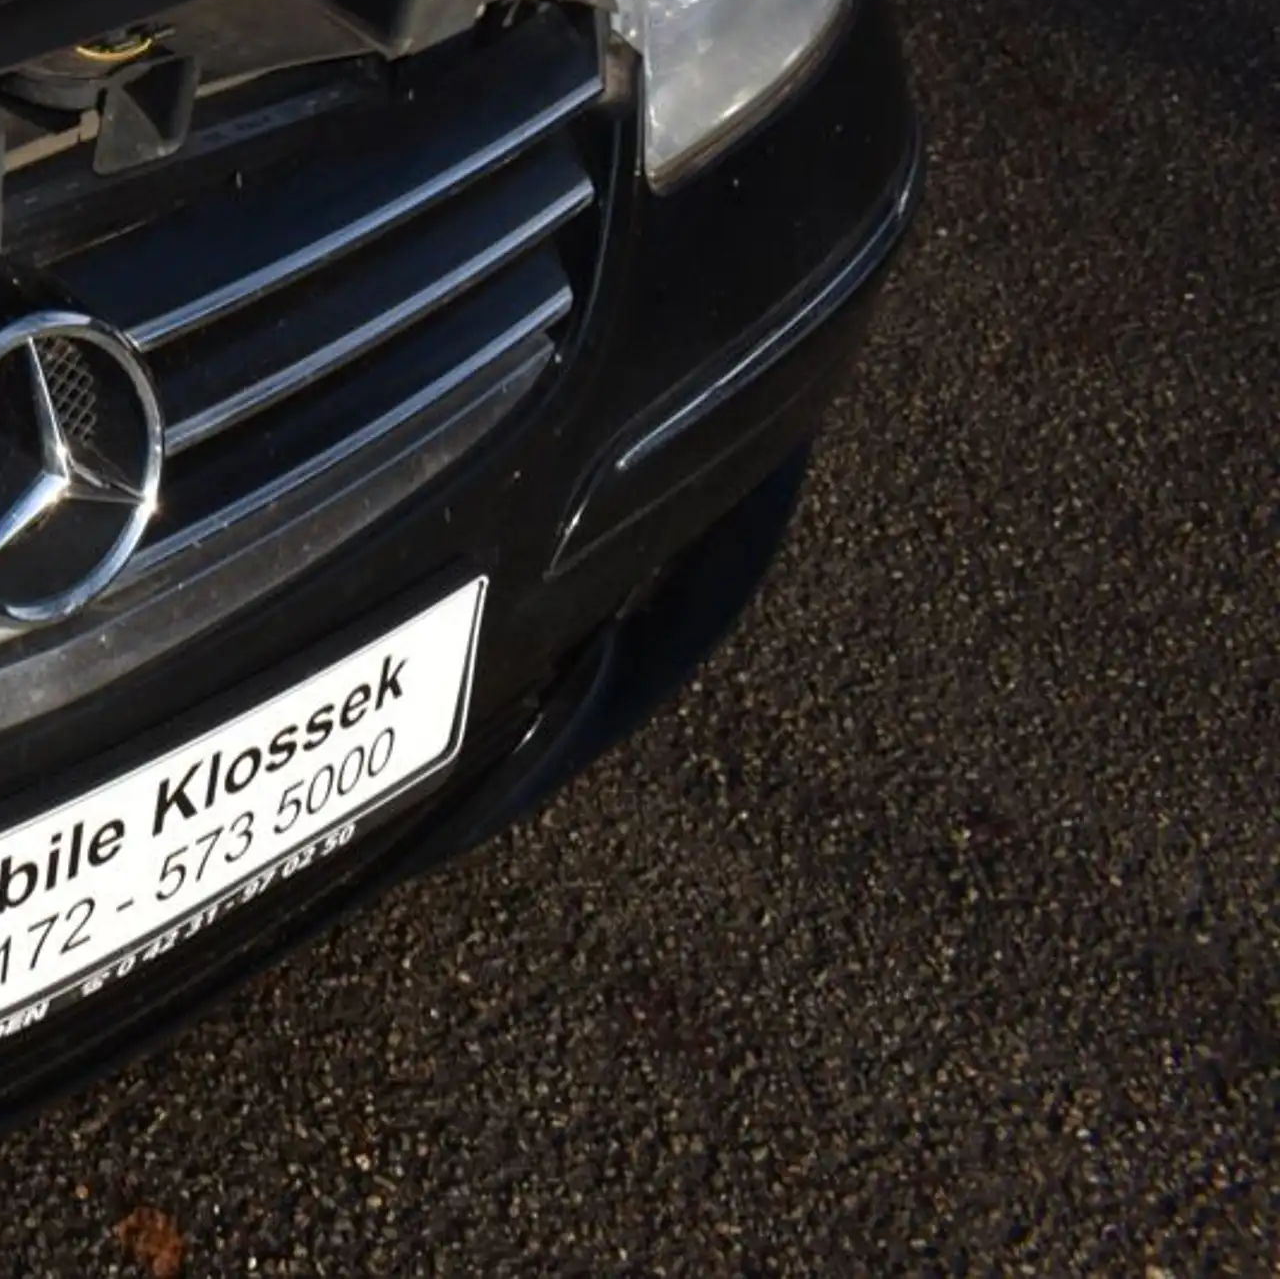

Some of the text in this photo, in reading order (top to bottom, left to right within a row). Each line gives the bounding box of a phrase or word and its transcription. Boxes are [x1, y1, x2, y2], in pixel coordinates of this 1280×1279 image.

[151, 654, 408, 839] Klossek
[155, 810, 256, 903] 573
[272, 726, 396, 836] 5000
